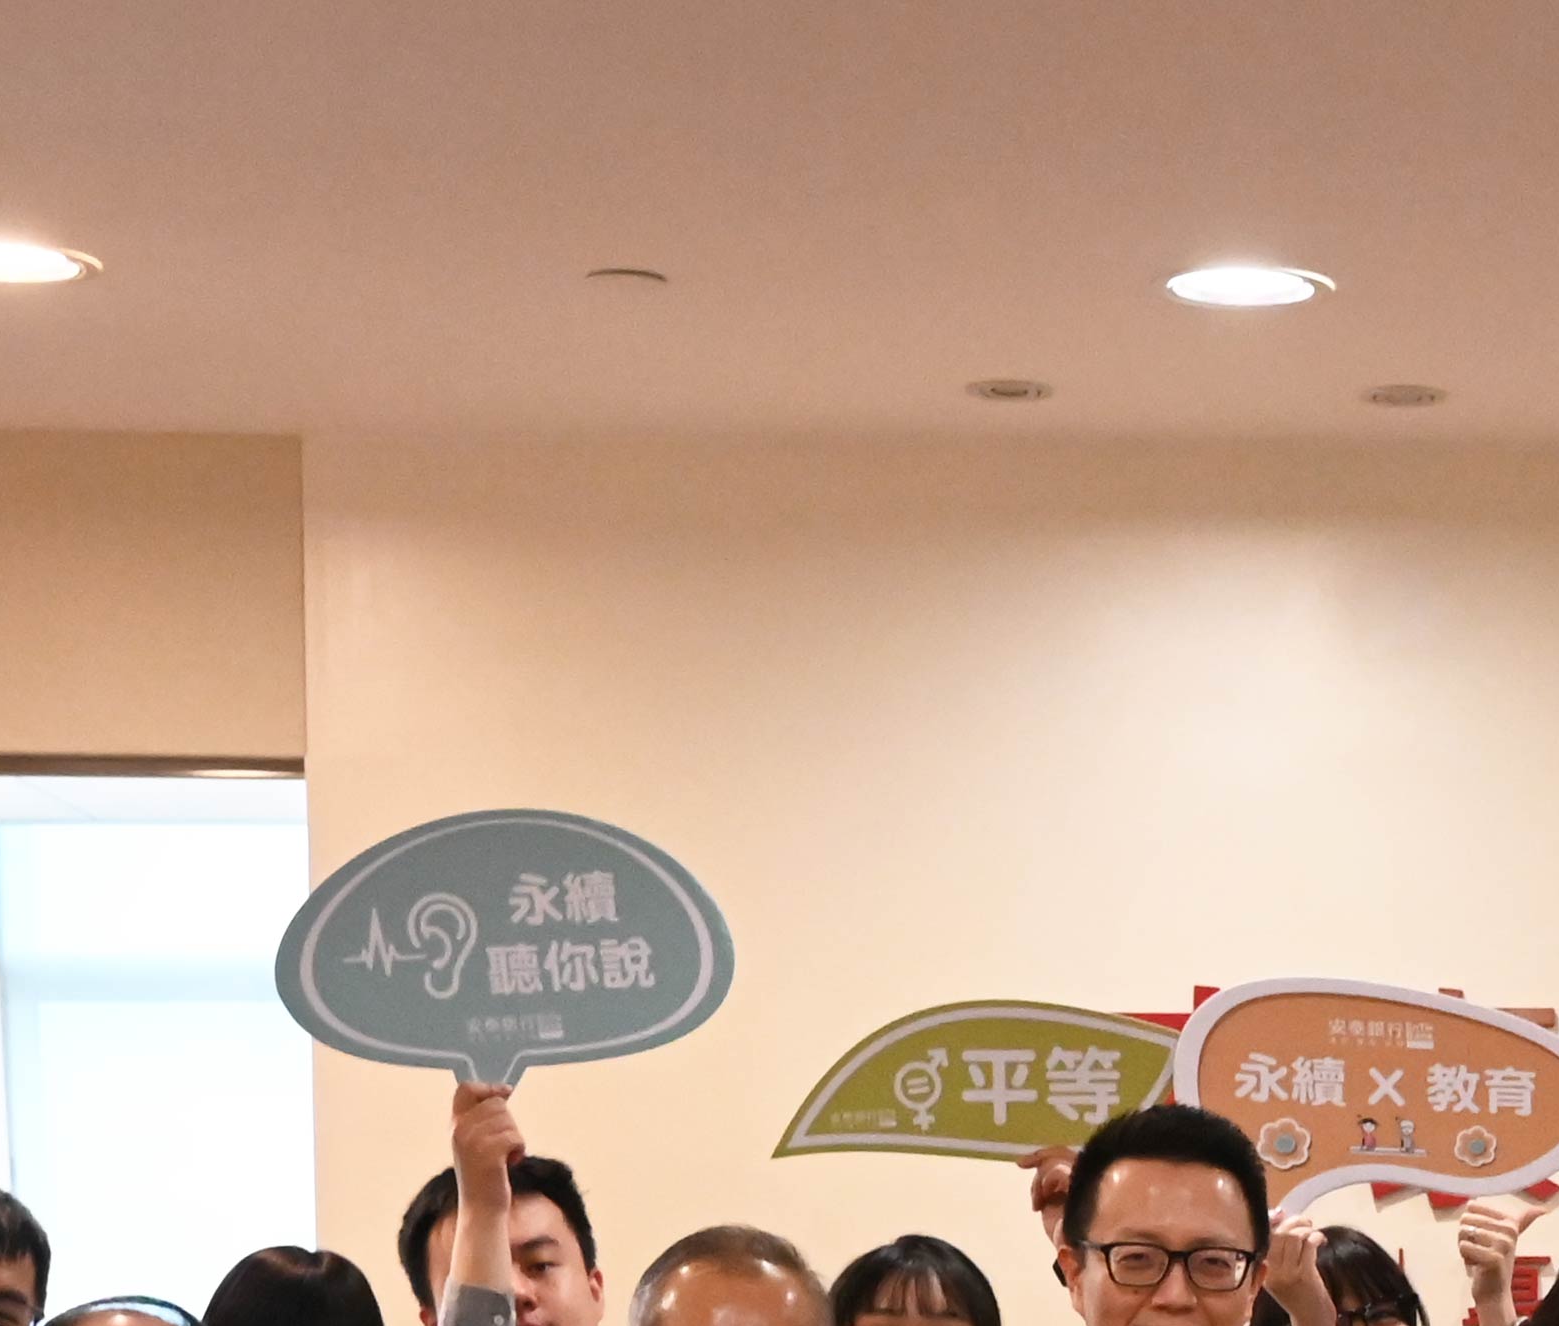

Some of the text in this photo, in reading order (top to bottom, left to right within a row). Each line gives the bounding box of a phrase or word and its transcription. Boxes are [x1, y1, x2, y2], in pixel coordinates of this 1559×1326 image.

[508, 870, 619, 926] 永續
[485, 936, 655, 995] 聽你說
[962, 1045, 1122, 1126] 平等
[1234, 1052, 1347, 1107] 永續
[1426, 1062, 1536, 1116] 教育
